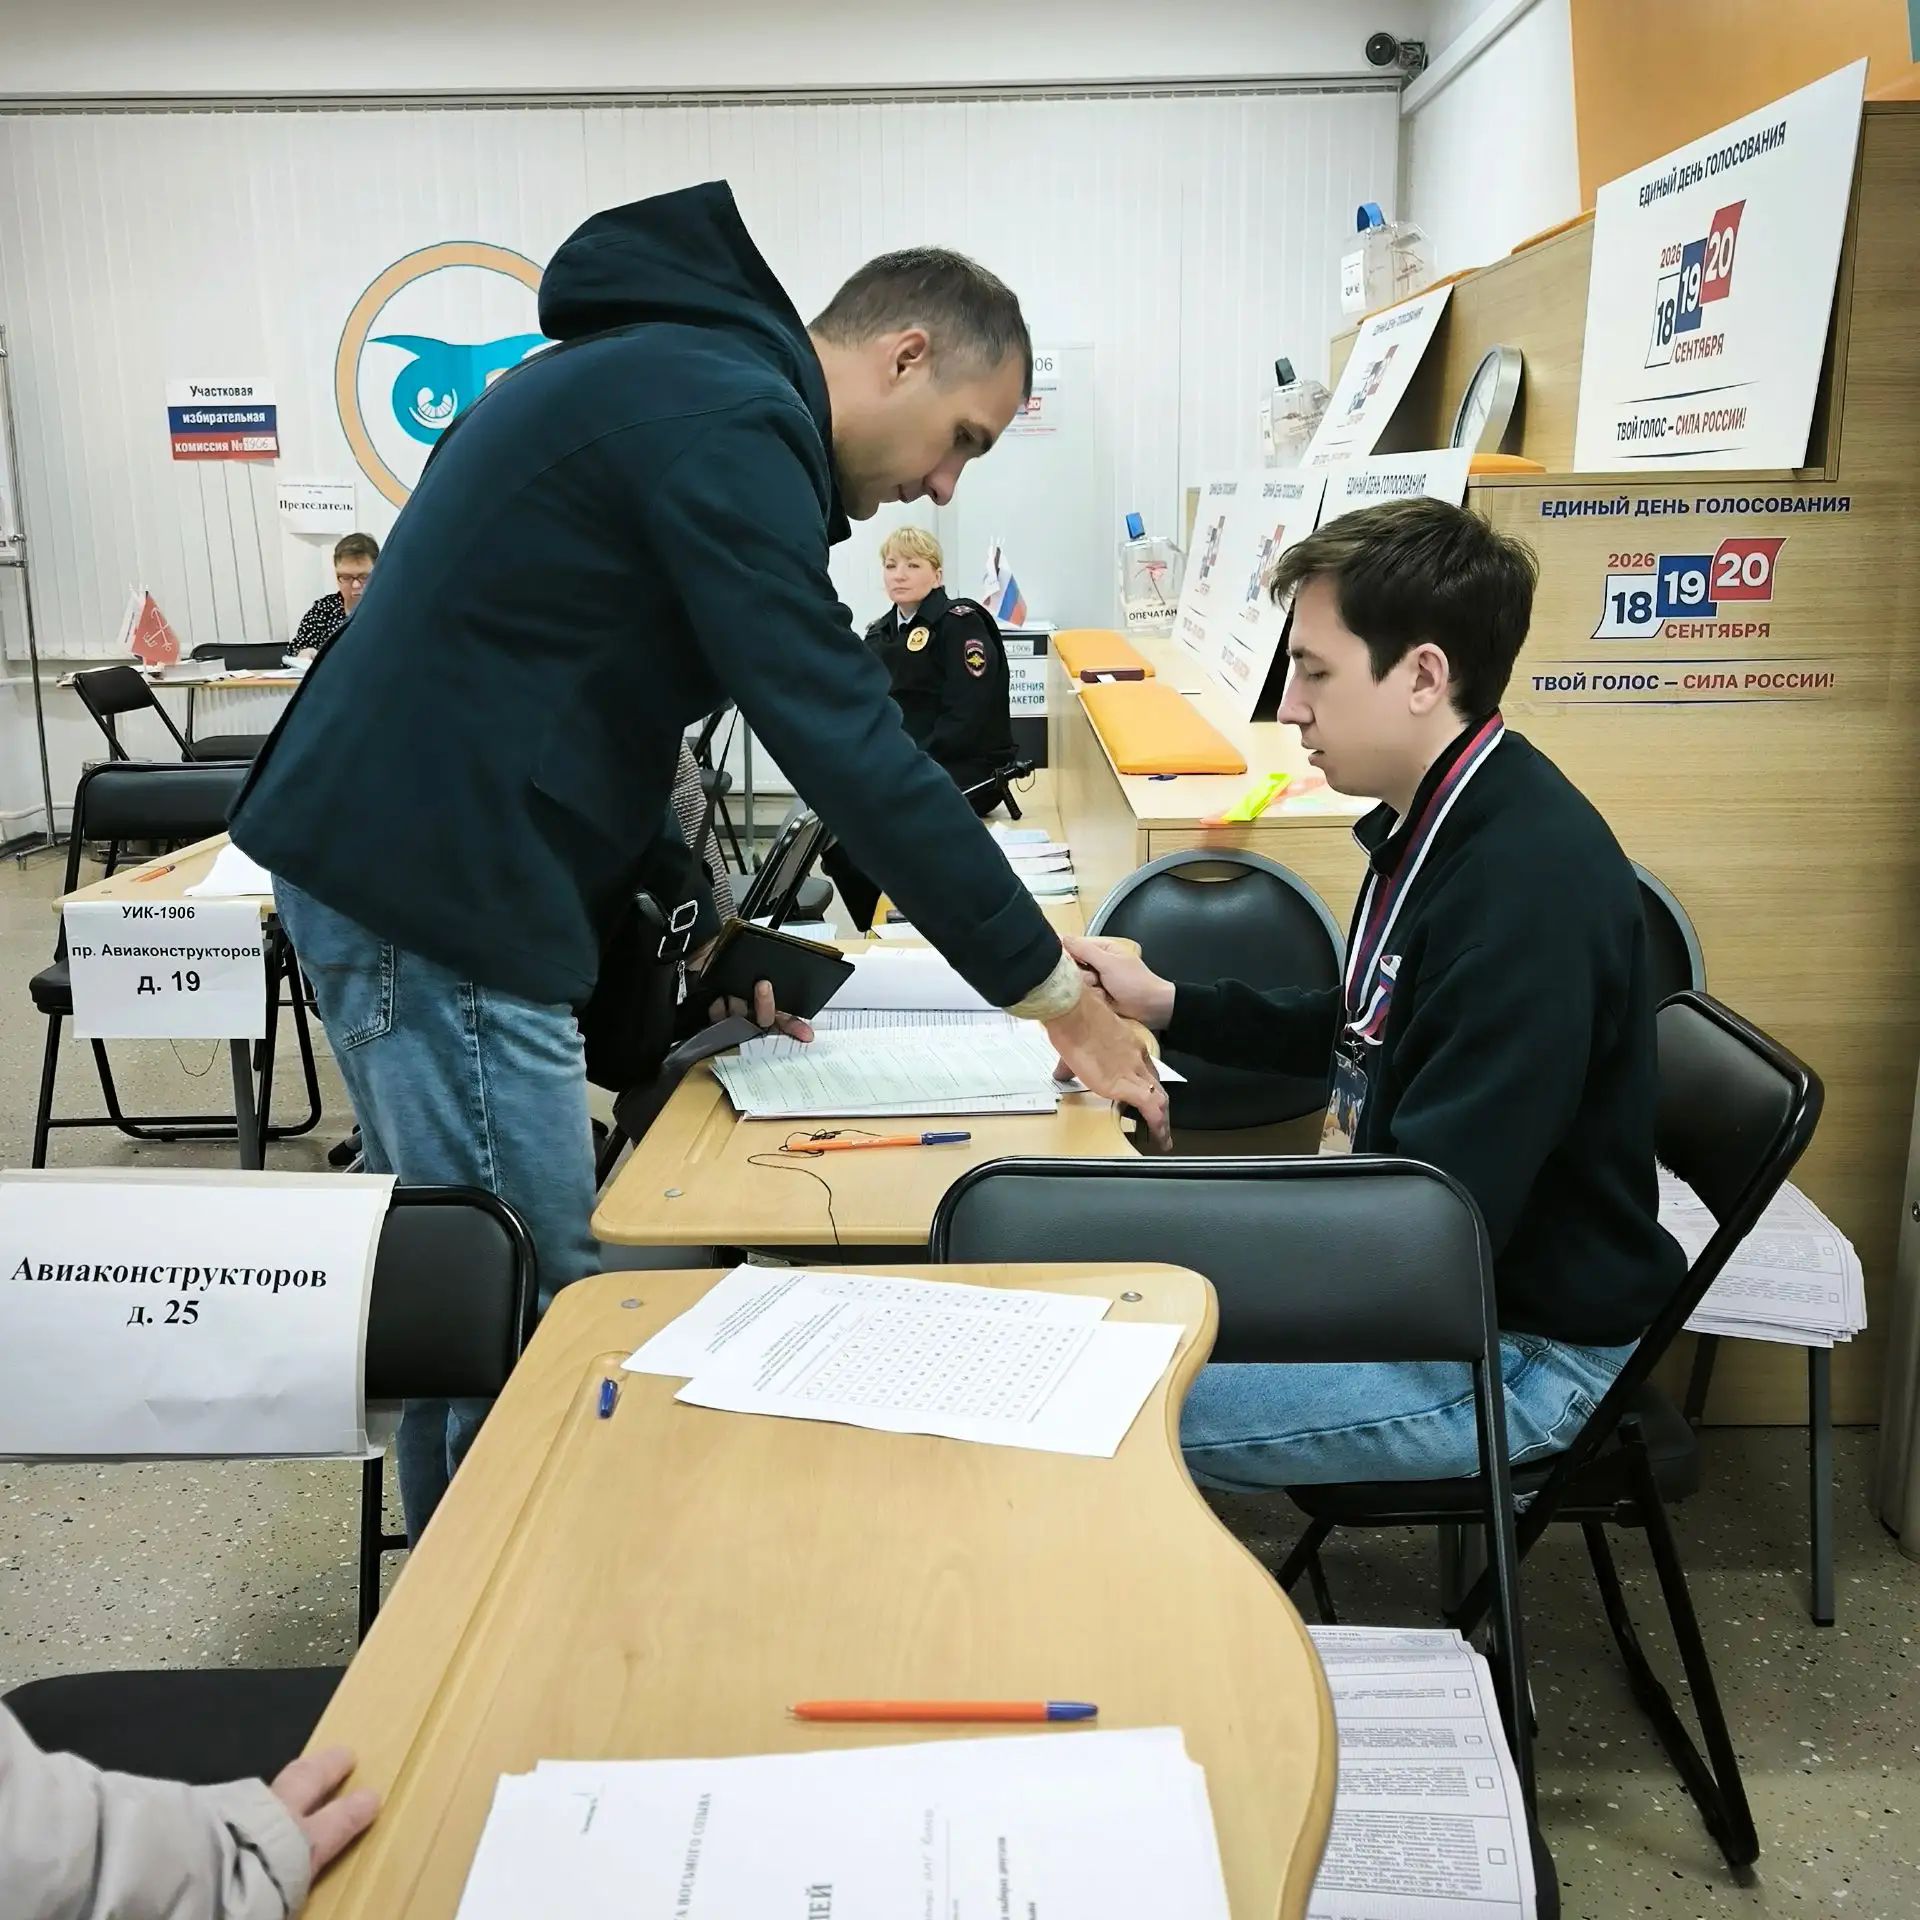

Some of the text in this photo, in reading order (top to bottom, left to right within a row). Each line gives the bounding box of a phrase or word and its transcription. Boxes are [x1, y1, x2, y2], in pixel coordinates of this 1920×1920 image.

[1639, 120, 1787, 208] ЕДИНЫЙ ДЕНЬ ГОЛОСОВАНИЯ
[1660, 242, 1682, 269] 2026
[1705, 226, 1735, 283] 20
[1680, 262, 1701, 315] 19
[1656, 298, 1675, 347] 18
[1675, 333, 1725, 364] СЕНТЯБРЯ
[1034, 357, 1053, 371] 06
[190, 385, 253, 397] Участковая
[182, 411, 265, 425] избирательная
[1616, 414, 1638, 442] ТВОЙ
[1638, 417, 1667, 441] ГОЛОС
[1675, 413, 1700, 436] СИЛА
[1702, 407, 1746, 434] РОССИИ!
[174, 442, 230, 452] комиссия
[1541, 496, 1851, 518] ЕДИНЫЙ ДЕНЬ ГОЛОСОВАНИЯ
[1607, 552, 1656, 568] 2026
[1716, 552, 1770, 587] 20
[1663, 570, 1706, 605] 19
[1611, 591, 1653, 625] 18
[1664, 623, 1770, 639] СЕНТЯБРЯ
[1010, 669, 1026, 679] СТО
[1532, 672, 1586, 691] ТВОЙ
[1592, 675, 1660, 691] ГОЛОС
[1683, 674, 1739, 690] СИЛА
[1744, 673, 1835, 689] РОССИИ!
[1010, 682, 1045, 692] АНЕНИЯ
[1011, 695, 1045, 705] АКЕТОВ
[122, 906, 195, 919] УИК-1906
[72, 944, 261, 961] пр. Авиаконструкторов
[137, 971, 201, 995] д. 19
[11, 1257, 328, 1294] Авиаконструкторов
[126, 1300, 200, 1328] д. 25
